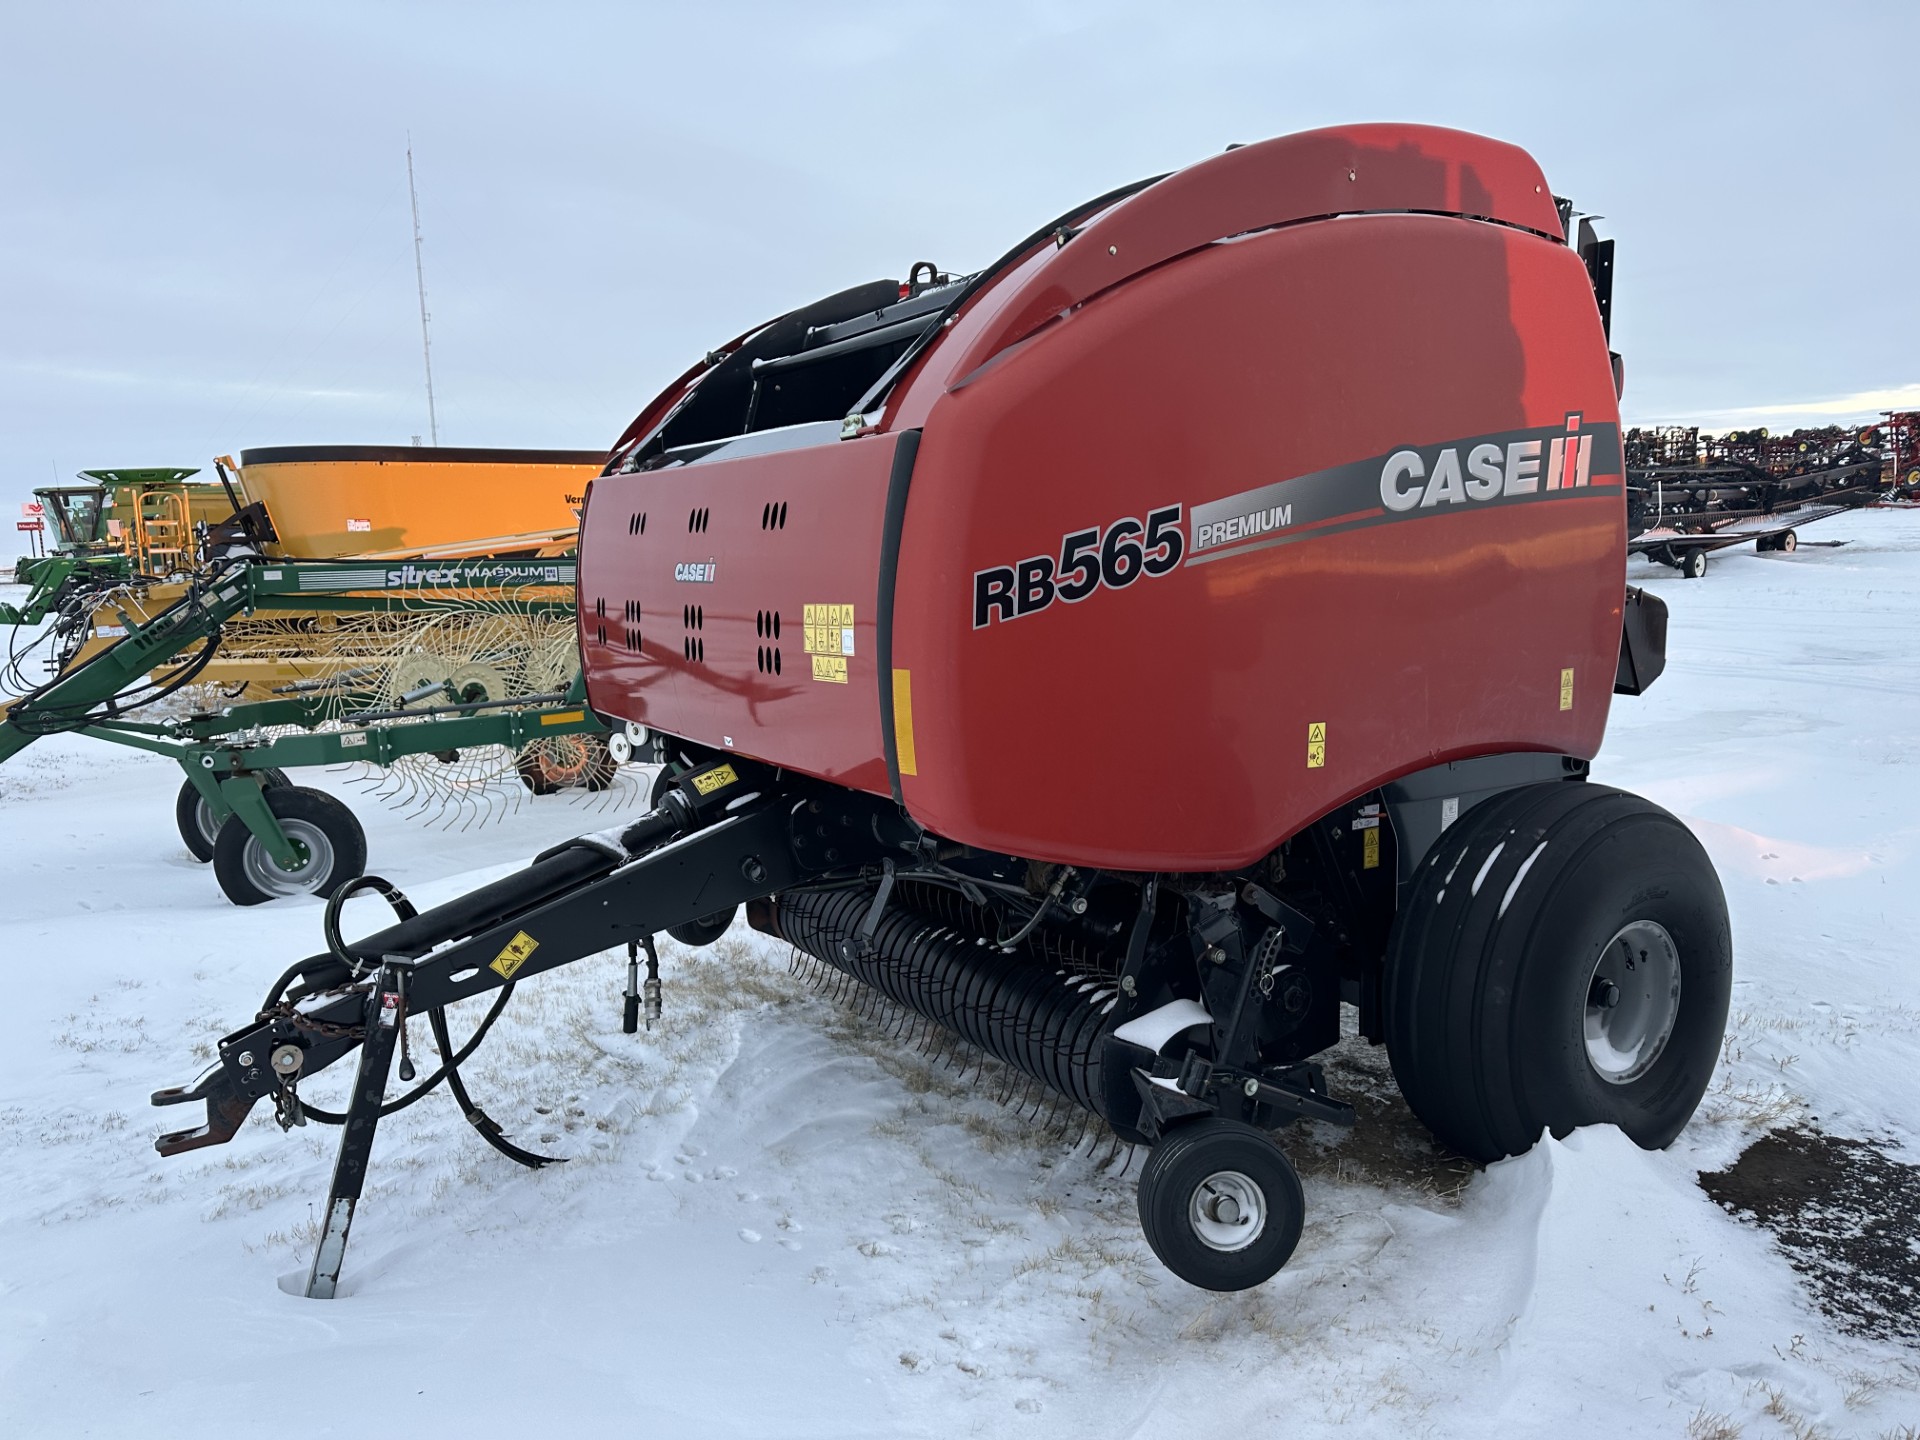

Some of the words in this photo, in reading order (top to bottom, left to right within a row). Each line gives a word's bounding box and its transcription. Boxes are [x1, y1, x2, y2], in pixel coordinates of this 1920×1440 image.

[1380, 440, 1542, 512] CASE
[387, 565, 462, 587] sitrex
[464, 566, 544, 578] MAGNUM
[973, 502, 1185, 630] RB565
[1197, 503, 1292, 549] PREMIUM
